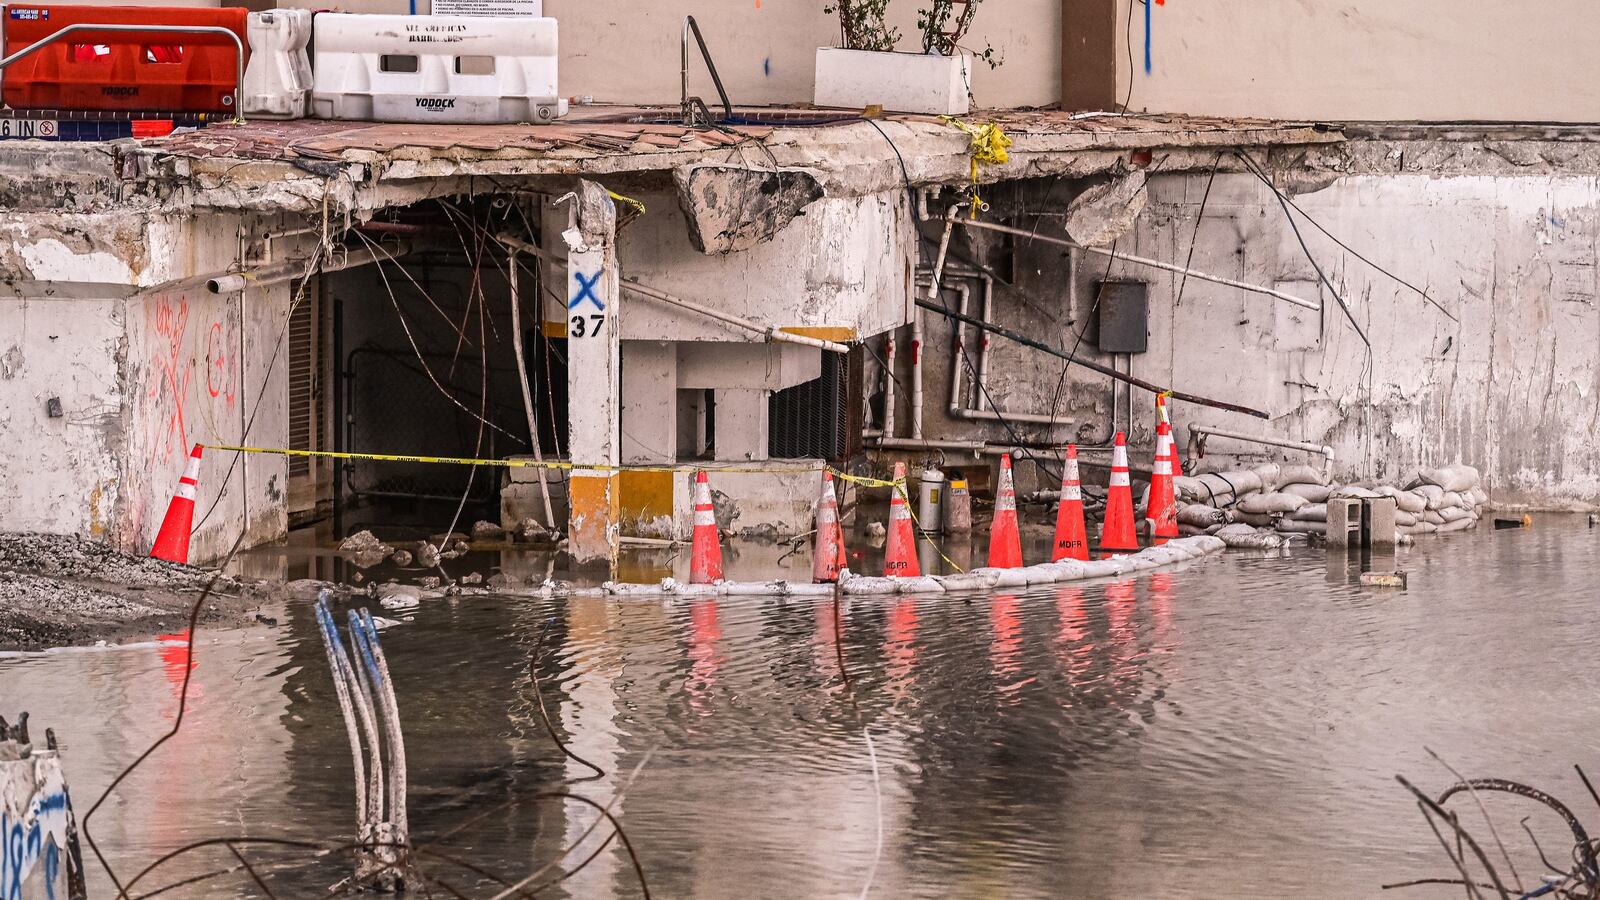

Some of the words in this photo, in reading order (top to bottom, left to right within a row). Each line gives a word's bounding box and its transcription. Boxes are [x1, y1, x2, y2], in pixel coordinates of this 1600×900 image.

[415, 97, 455, 108] YODOCK
[2, 120, 10, 136] 6
[19, 120, 34, 136] IN
[571, 314, 605, 338] 37
[1059, 540, 1082, 549] MDFR
